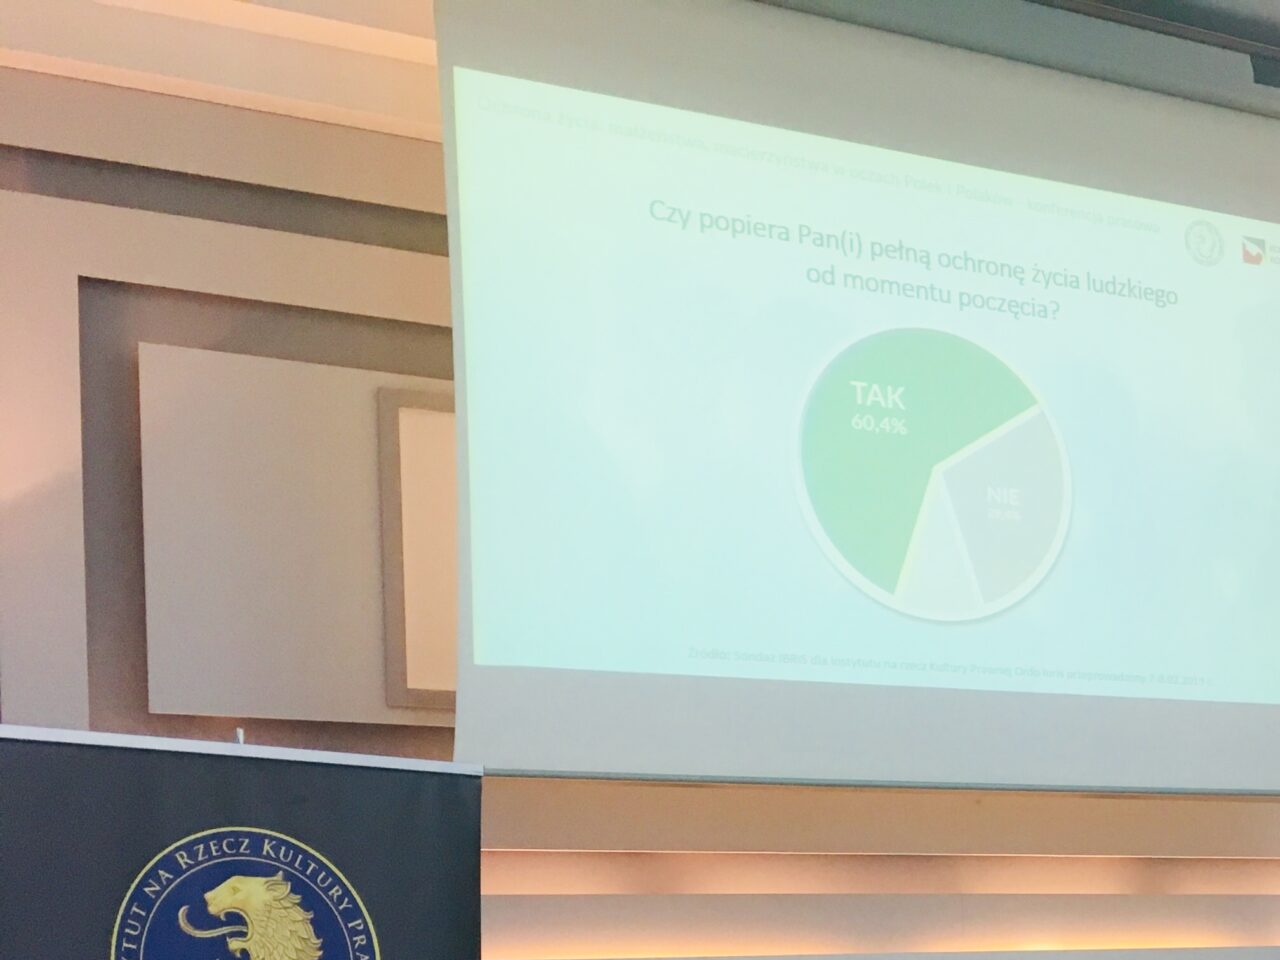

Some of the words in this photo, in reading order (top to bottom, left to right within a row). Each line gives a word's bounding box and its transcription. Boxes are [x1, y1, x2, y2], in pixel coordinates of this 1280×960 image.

[649, 199, 692, 230] Czy
[700, 211, 790, 242] popiera
[799, 223, 862, 259] Pan(i)
[870, 240, 932, 271] pełną
[938, 250, 1025, 287] ochronę
[1031, 263, 1080, 290] życia
[1086, 271, 1179, 308] ludzkiego
[806, 264, 835, 285] od
[843, 272, 952, 304] momentu
[958, 288, 1060, 321] poczęcia?
[850, 380, 905, 410] TAK
[851, 414, 908, 436] 60,4%
[986, 486, 1021, 506] NIE
[143, 868, 174, 899] NA
[174, 838, 250, 870] RZECZ
[262, 838, 353, 912] KULTURY
